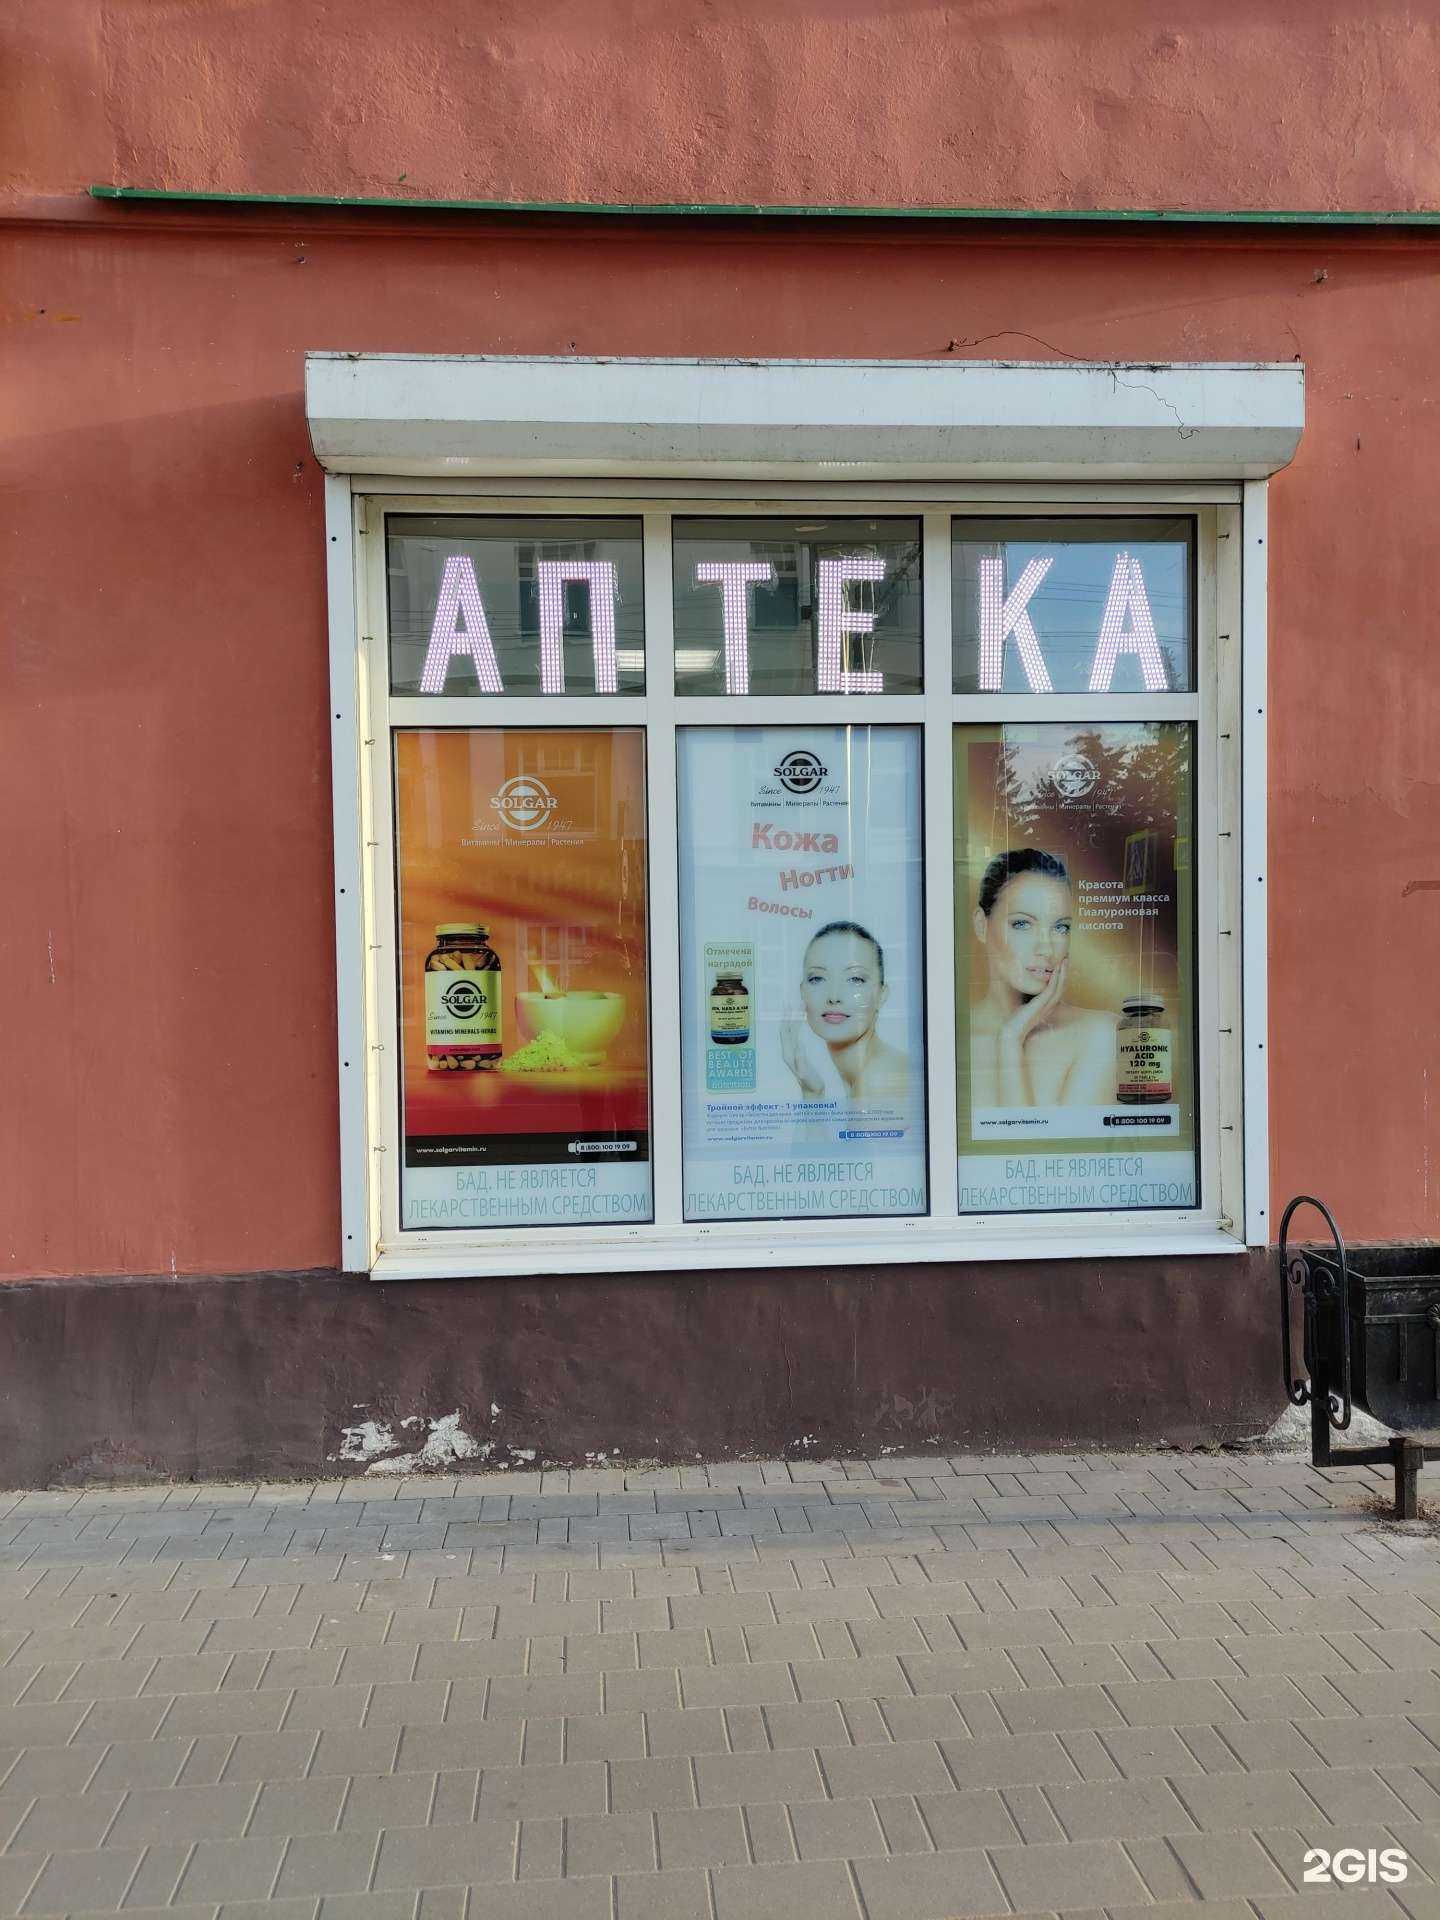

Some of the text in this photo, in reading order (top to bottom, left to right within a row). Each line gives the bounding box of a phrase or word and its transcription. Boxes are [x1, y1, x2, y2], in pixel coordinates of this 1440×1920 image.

[419, 553, 1169, 694] АПТЕКА
[773, 767, 828, 777] SOLGAR
[758, 785, 782, 795] Since
[489, 797, 559, 809] SOLGAR
[546, 819, 573, 832] 1947
[751, 821, 839, 854] Кожа
[779, 863, 855, 892] Ногти
[1078, 879, 1124, 891] Красота
[1078, 893, 1170, 904] премиум класса
[747, 896, 813, 919] Волосы
[1078, 907, 1159, 918] Гиалуроновая
[1078, 921, 1124, 930] кислота
[706, 947, 752, 956] Отмечена
[708, 959, 753, 969] наградой
[440, 995, 488, 1005] SOLGAR
[1134, 1052, 1155, 1060] ACID
[706, 1103, 744, 1112] Тройной
[745, 1103, 779, 1112] эффект
[792, 1102, 837, 1111] упаковка!
[733, 1161, 873, 1187] БАД. НЕ ЯВЛЯЕТСЯ
[1005, 1157, 1143, 1180] БАД. НЕ ЯВЛЯЕТСЯ
[456, 1168, 597, 1193] БАД. НЕ ЯВЛЯЕТСЯ
[685, 1187, 924, 1212] ЛЕКАРСТВЕННЫМ СРЕДСТВОМ
[959, 1182, 1193, 1207] ЛЕКАРСТВЕННЫМ СРЕДСТВОМ
[408, 1193, 648, 1219] ЛЕКАРСТВЕННЫМ СРЕДСТВОМ
